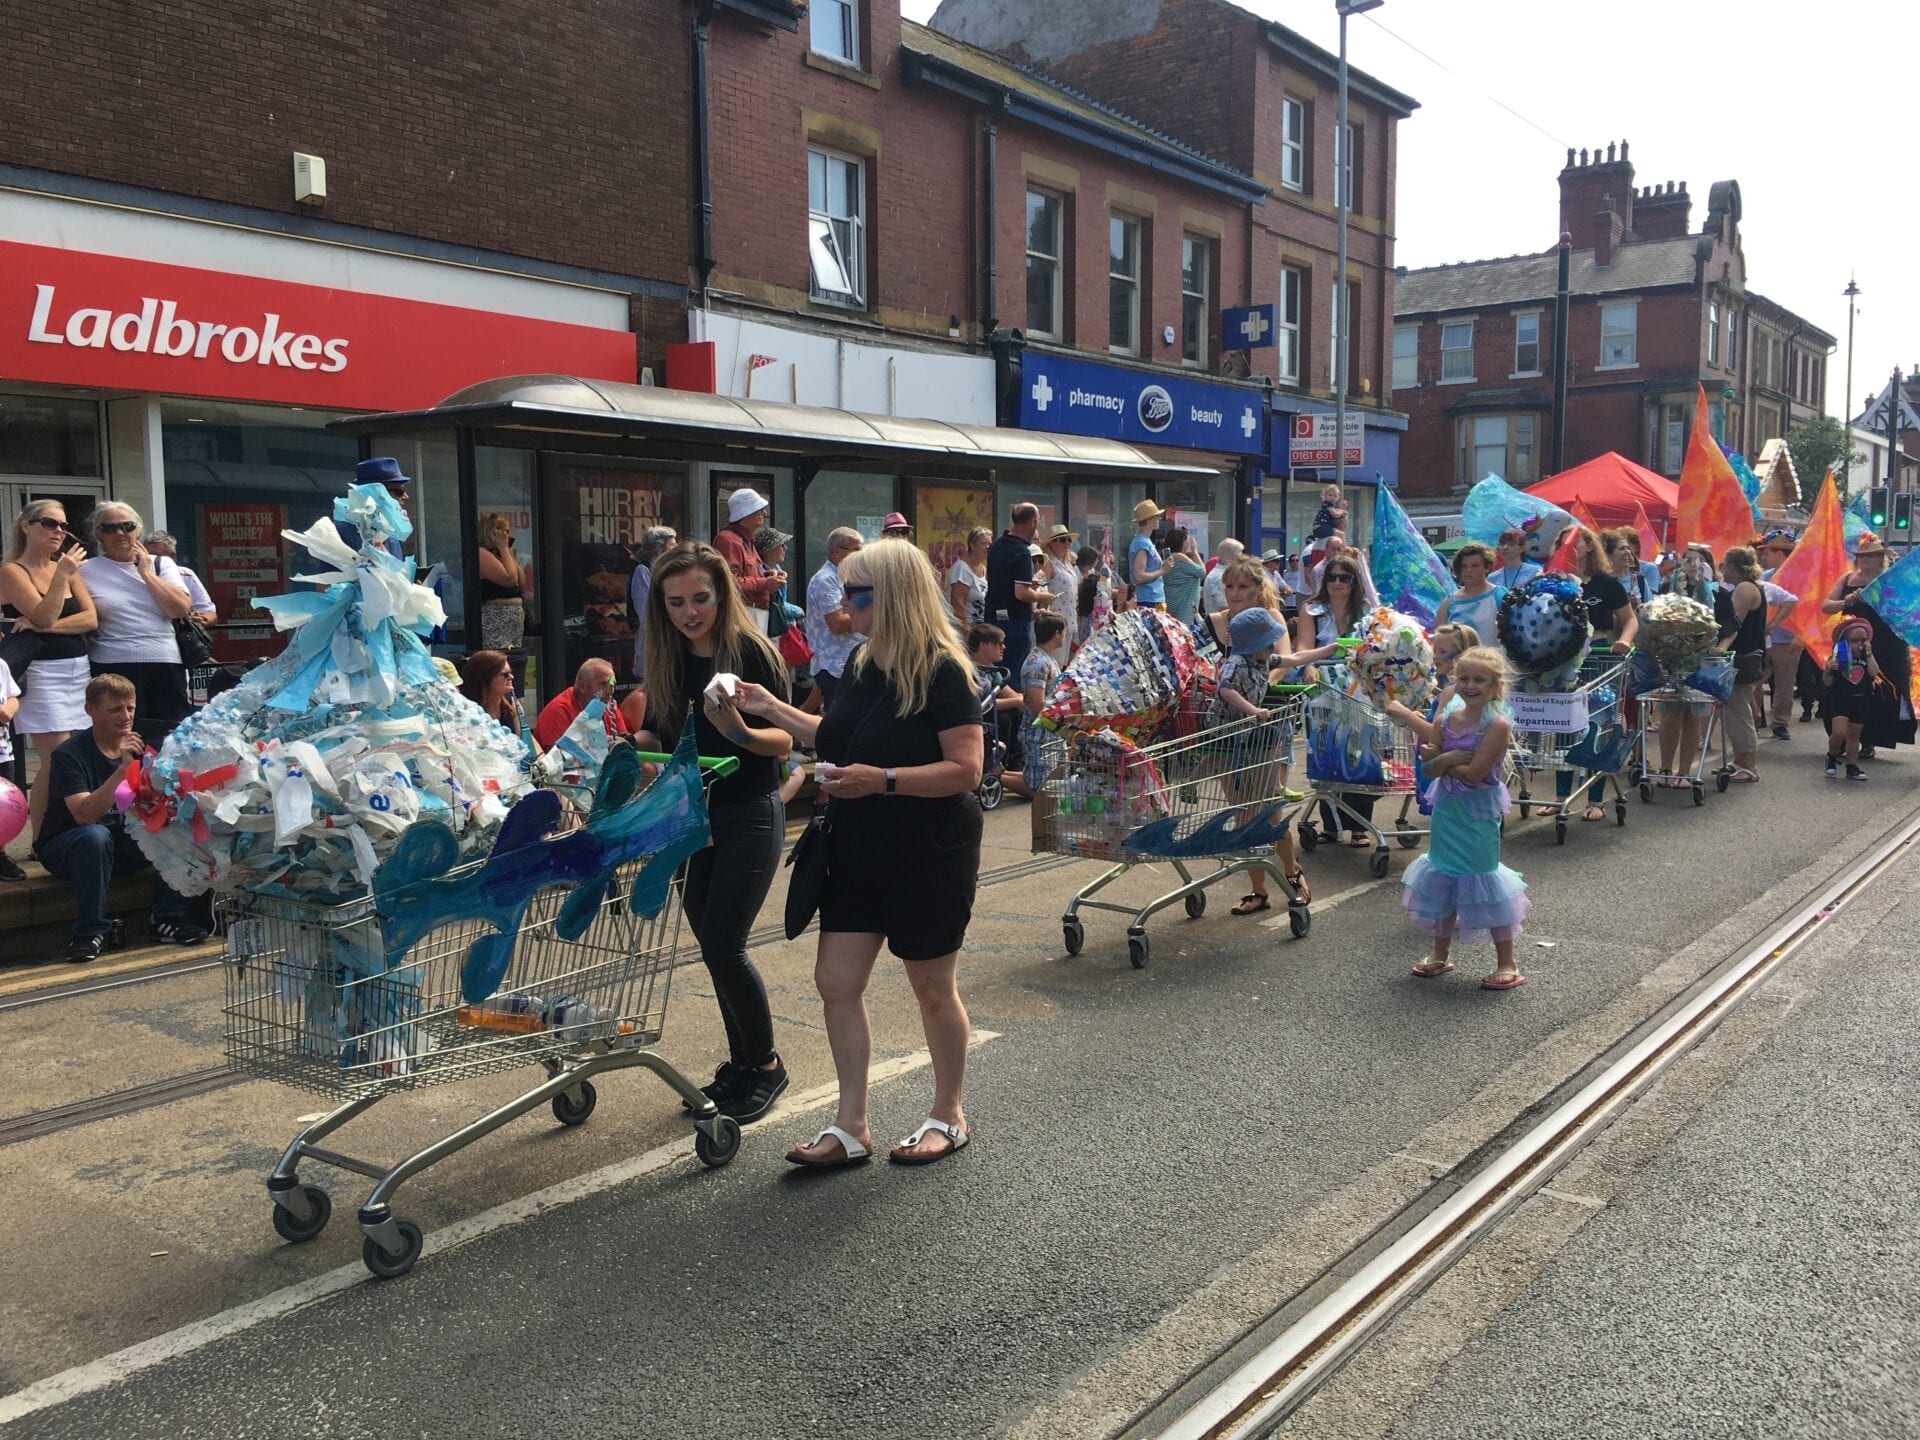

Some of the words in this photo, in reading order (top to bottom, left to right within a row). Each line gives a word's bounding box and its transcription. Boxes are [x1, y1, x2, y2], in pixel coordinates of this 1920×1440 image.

[28, 284, 349, 373] Ladbrokes
[1069, 387, 1125, 414] pharmacy
[1191, 404, 1223, 428] beauty
[1319, 422, 1359, 431] Avable
[1292, 450, 1313, 460] 0161
[1316, 450, 1333, 460] 631
[579, 486, 662, 516] HURRY
[209, 512, 252, 526] WHAT'S
[254, 512, 274, 526] THE
[857, 518, 868, 526] TO
[870, 518, 884, 526] LET
[222, 526, 263, 540] SCORE?
[1515, 696, 1541, 704] Church
